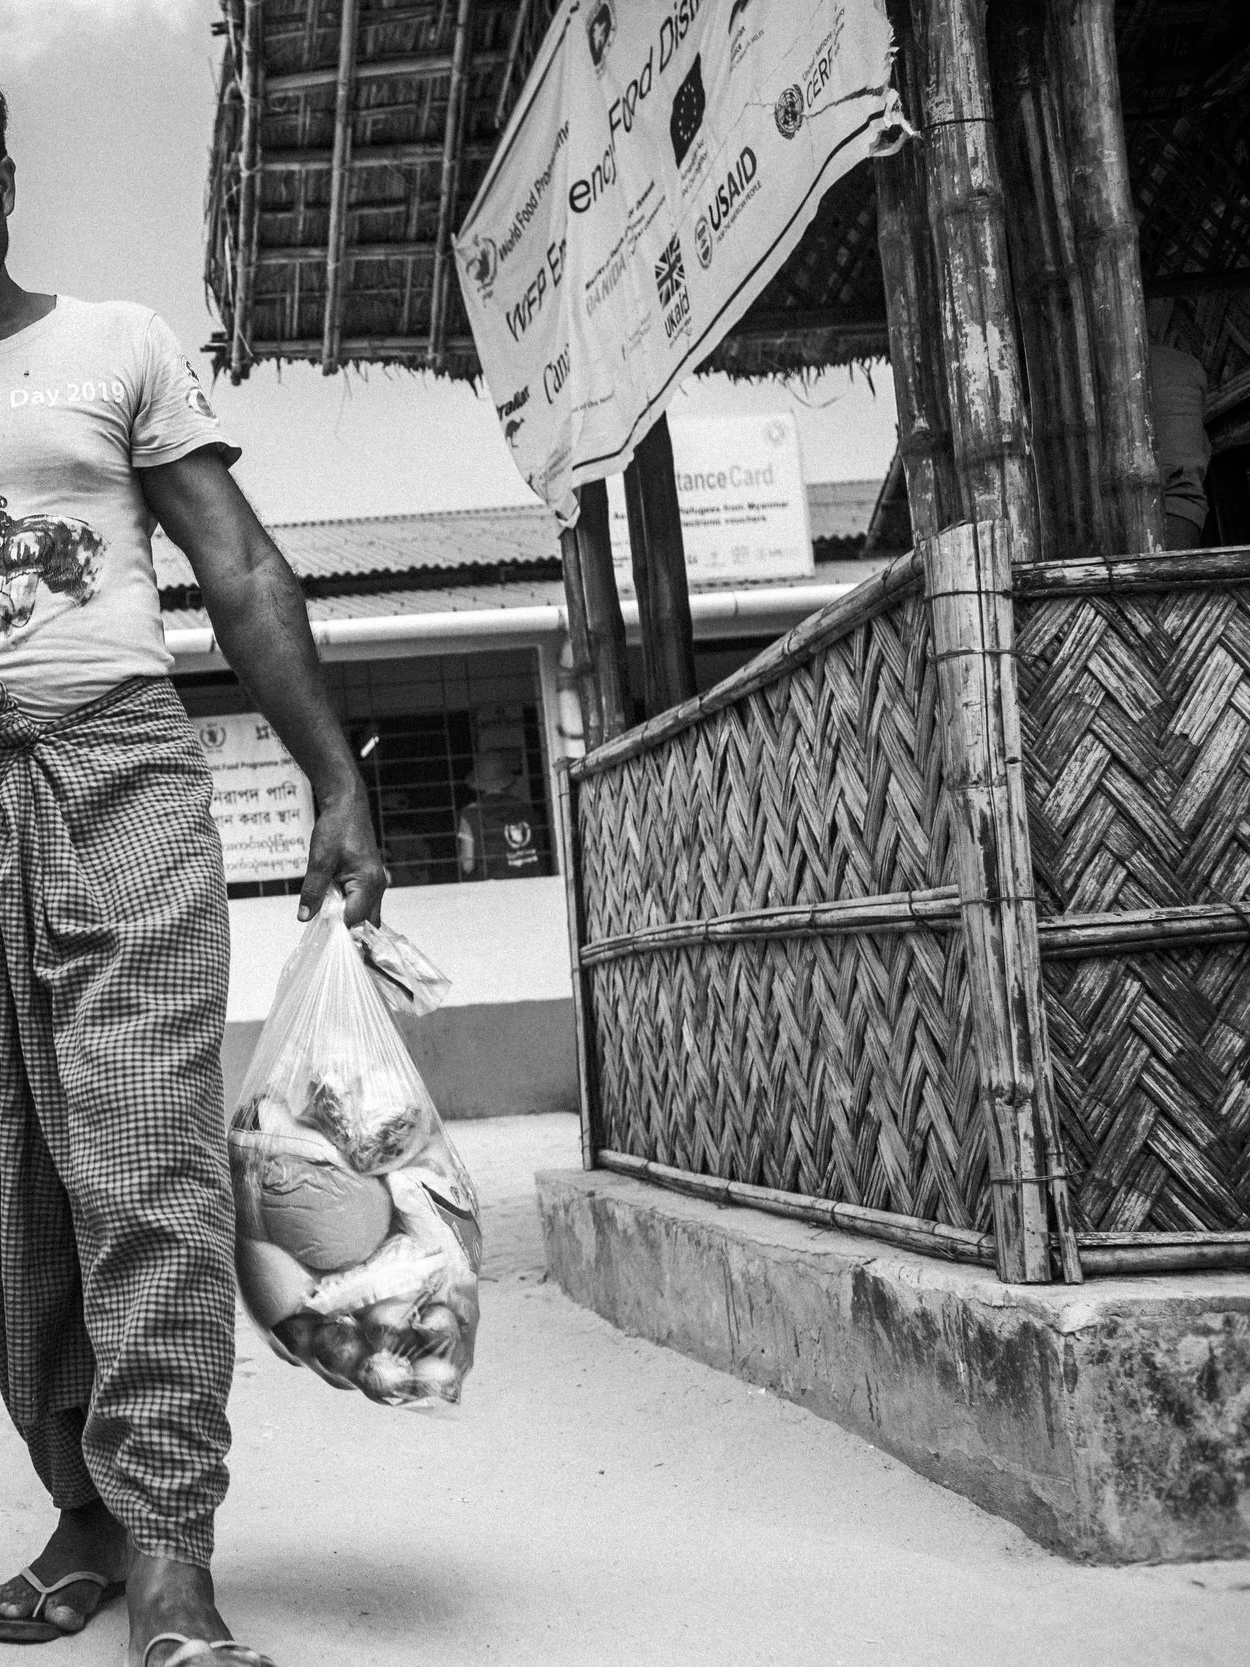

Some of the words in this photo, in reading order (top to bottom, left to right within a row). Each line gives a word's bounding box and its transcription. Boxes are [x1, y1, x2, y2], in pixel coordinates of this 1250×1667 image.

[806, 46, 833, 108] CERF
[505, 267, 547, 342] WFP
[608, 45, 654, 153] Food
[515, 189, 539, 231] Food
[708, 146, 757, 232] USAID
[9, 387, 60, 409] Day
[66, 380, 125, 403] 2019
